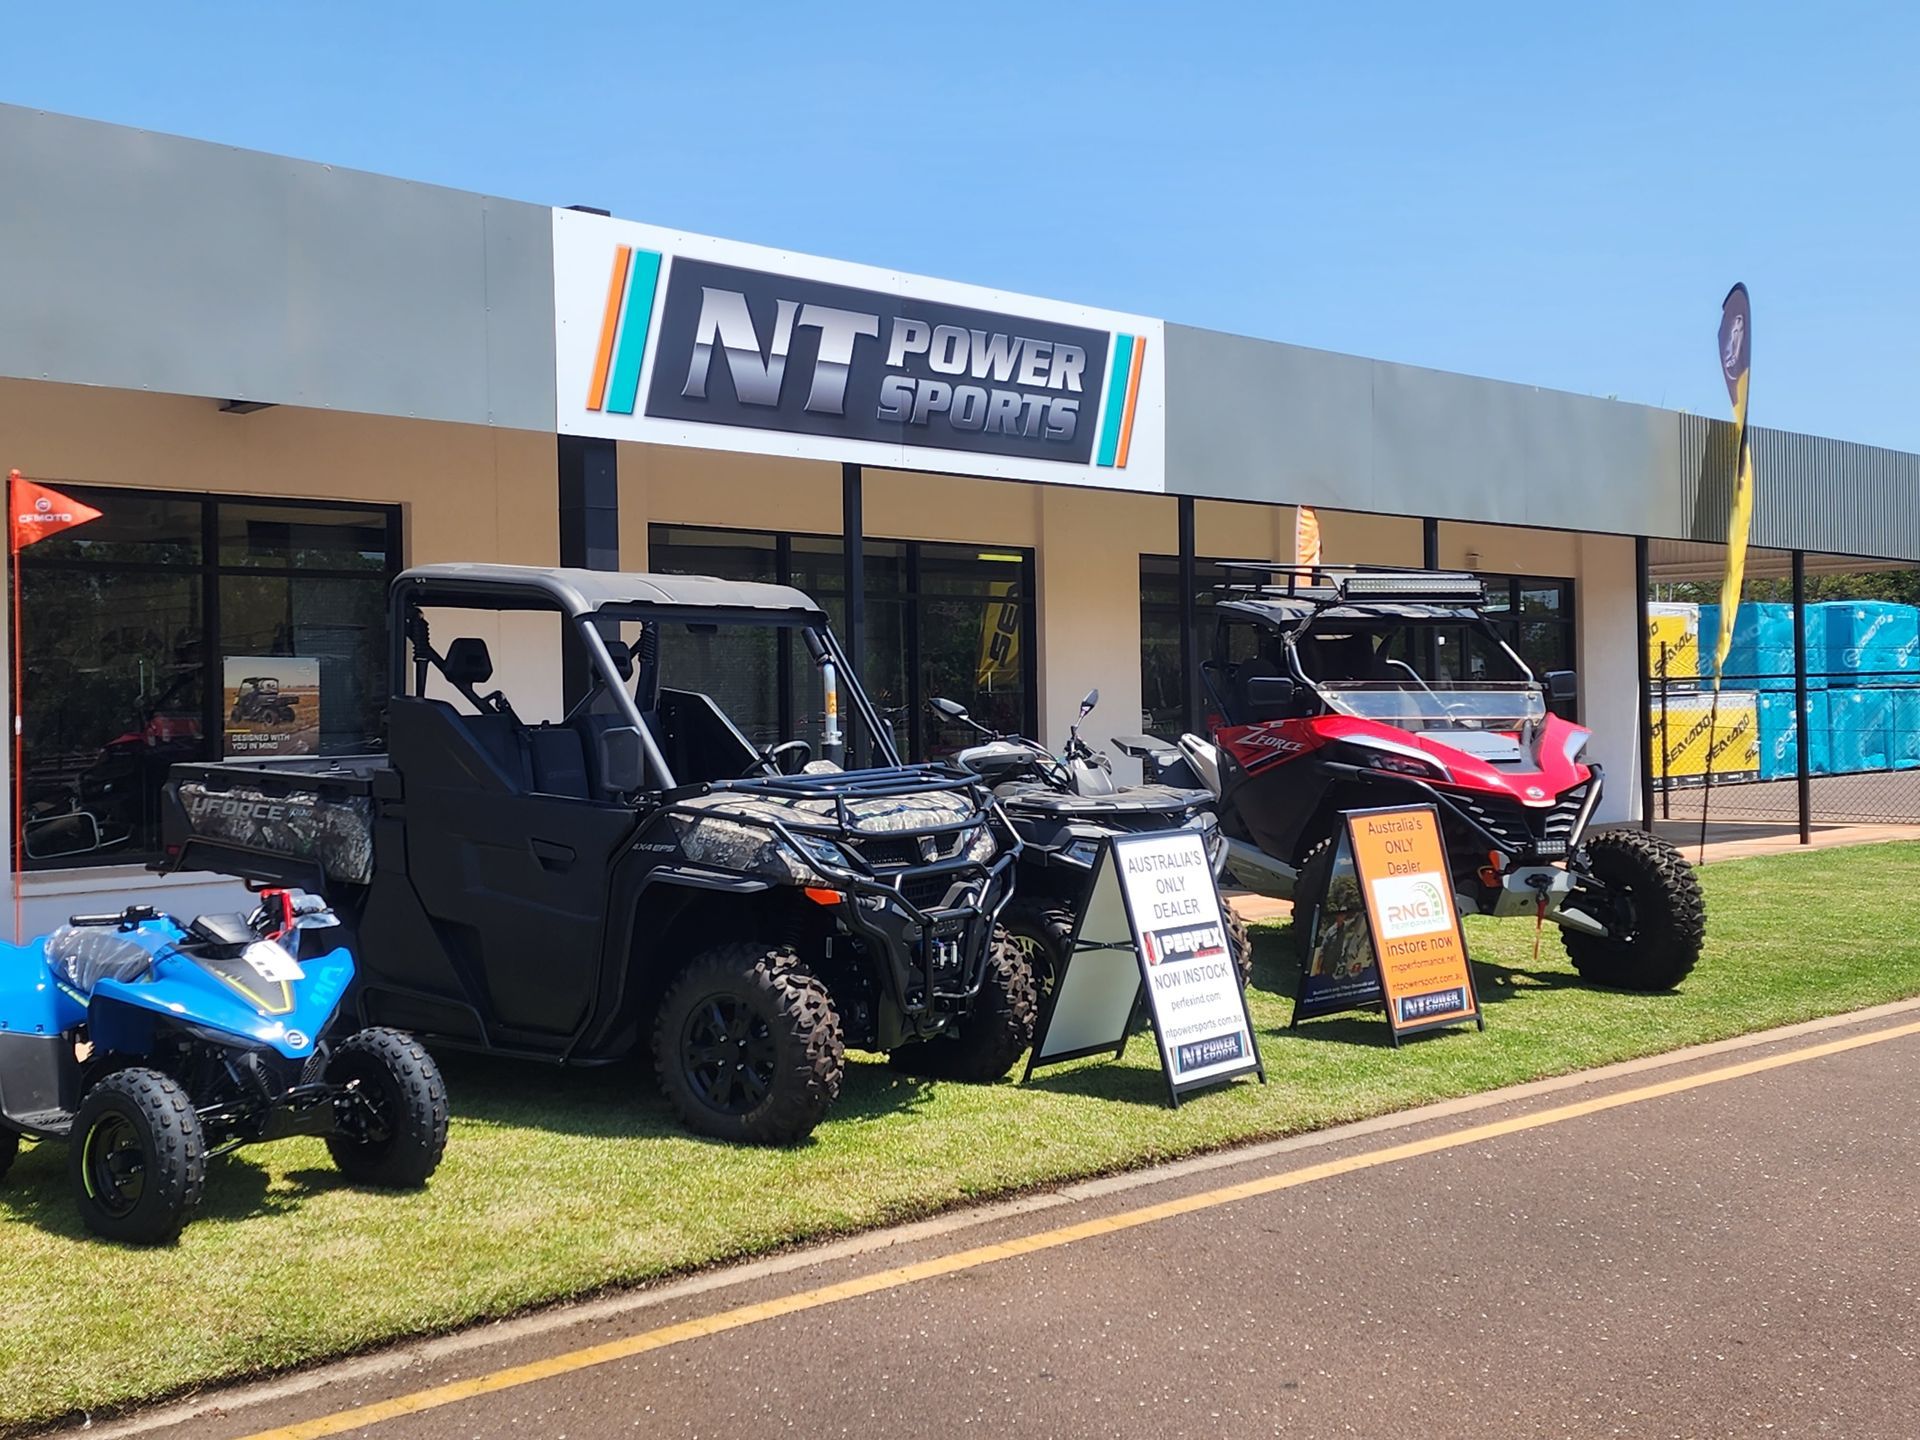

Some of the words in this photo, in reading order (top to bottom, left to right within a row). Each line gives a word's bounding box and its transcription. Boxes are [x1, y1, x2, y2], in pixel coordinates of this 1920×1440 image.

[680, 286, 880, 416] NT
[885, 315, 1088, 393] POWER
[876, 375, 1080, 442] SPORTS
[232, 734, 269, 742] DESIGNED
[271, 734, 290, 742] WITH
[259, 742, 278, 750] MIND
[1368, 817, 1423, 836] Australia's
[1385, 838, 1414, 854] ONLY
[1128, 850, 1202, 874] AUSTRALIA'S
[1387, 860, 1421, 875] Dealer
[1156, 876, 1186, 894] ONLY
[1153, 898, 1201, 919] DEALER
[1387, 902, 1430, 922] RNG
[1162, 927, 1225, 955] PERFEX
[1386, 940, 1428, 957] instore
[1430, 936, 1453, 950] now
[1154, 971, 1181, 990] NOW
[1183, 962, 1229, 984] INSTOCK
[1425, 991, 1458, 1005] POWER
[1404, 1000, 1425, 1017] NT
[1203, 1036, 1236, 1053] POWER
[1182, 1045, 1203, 1067] NT
